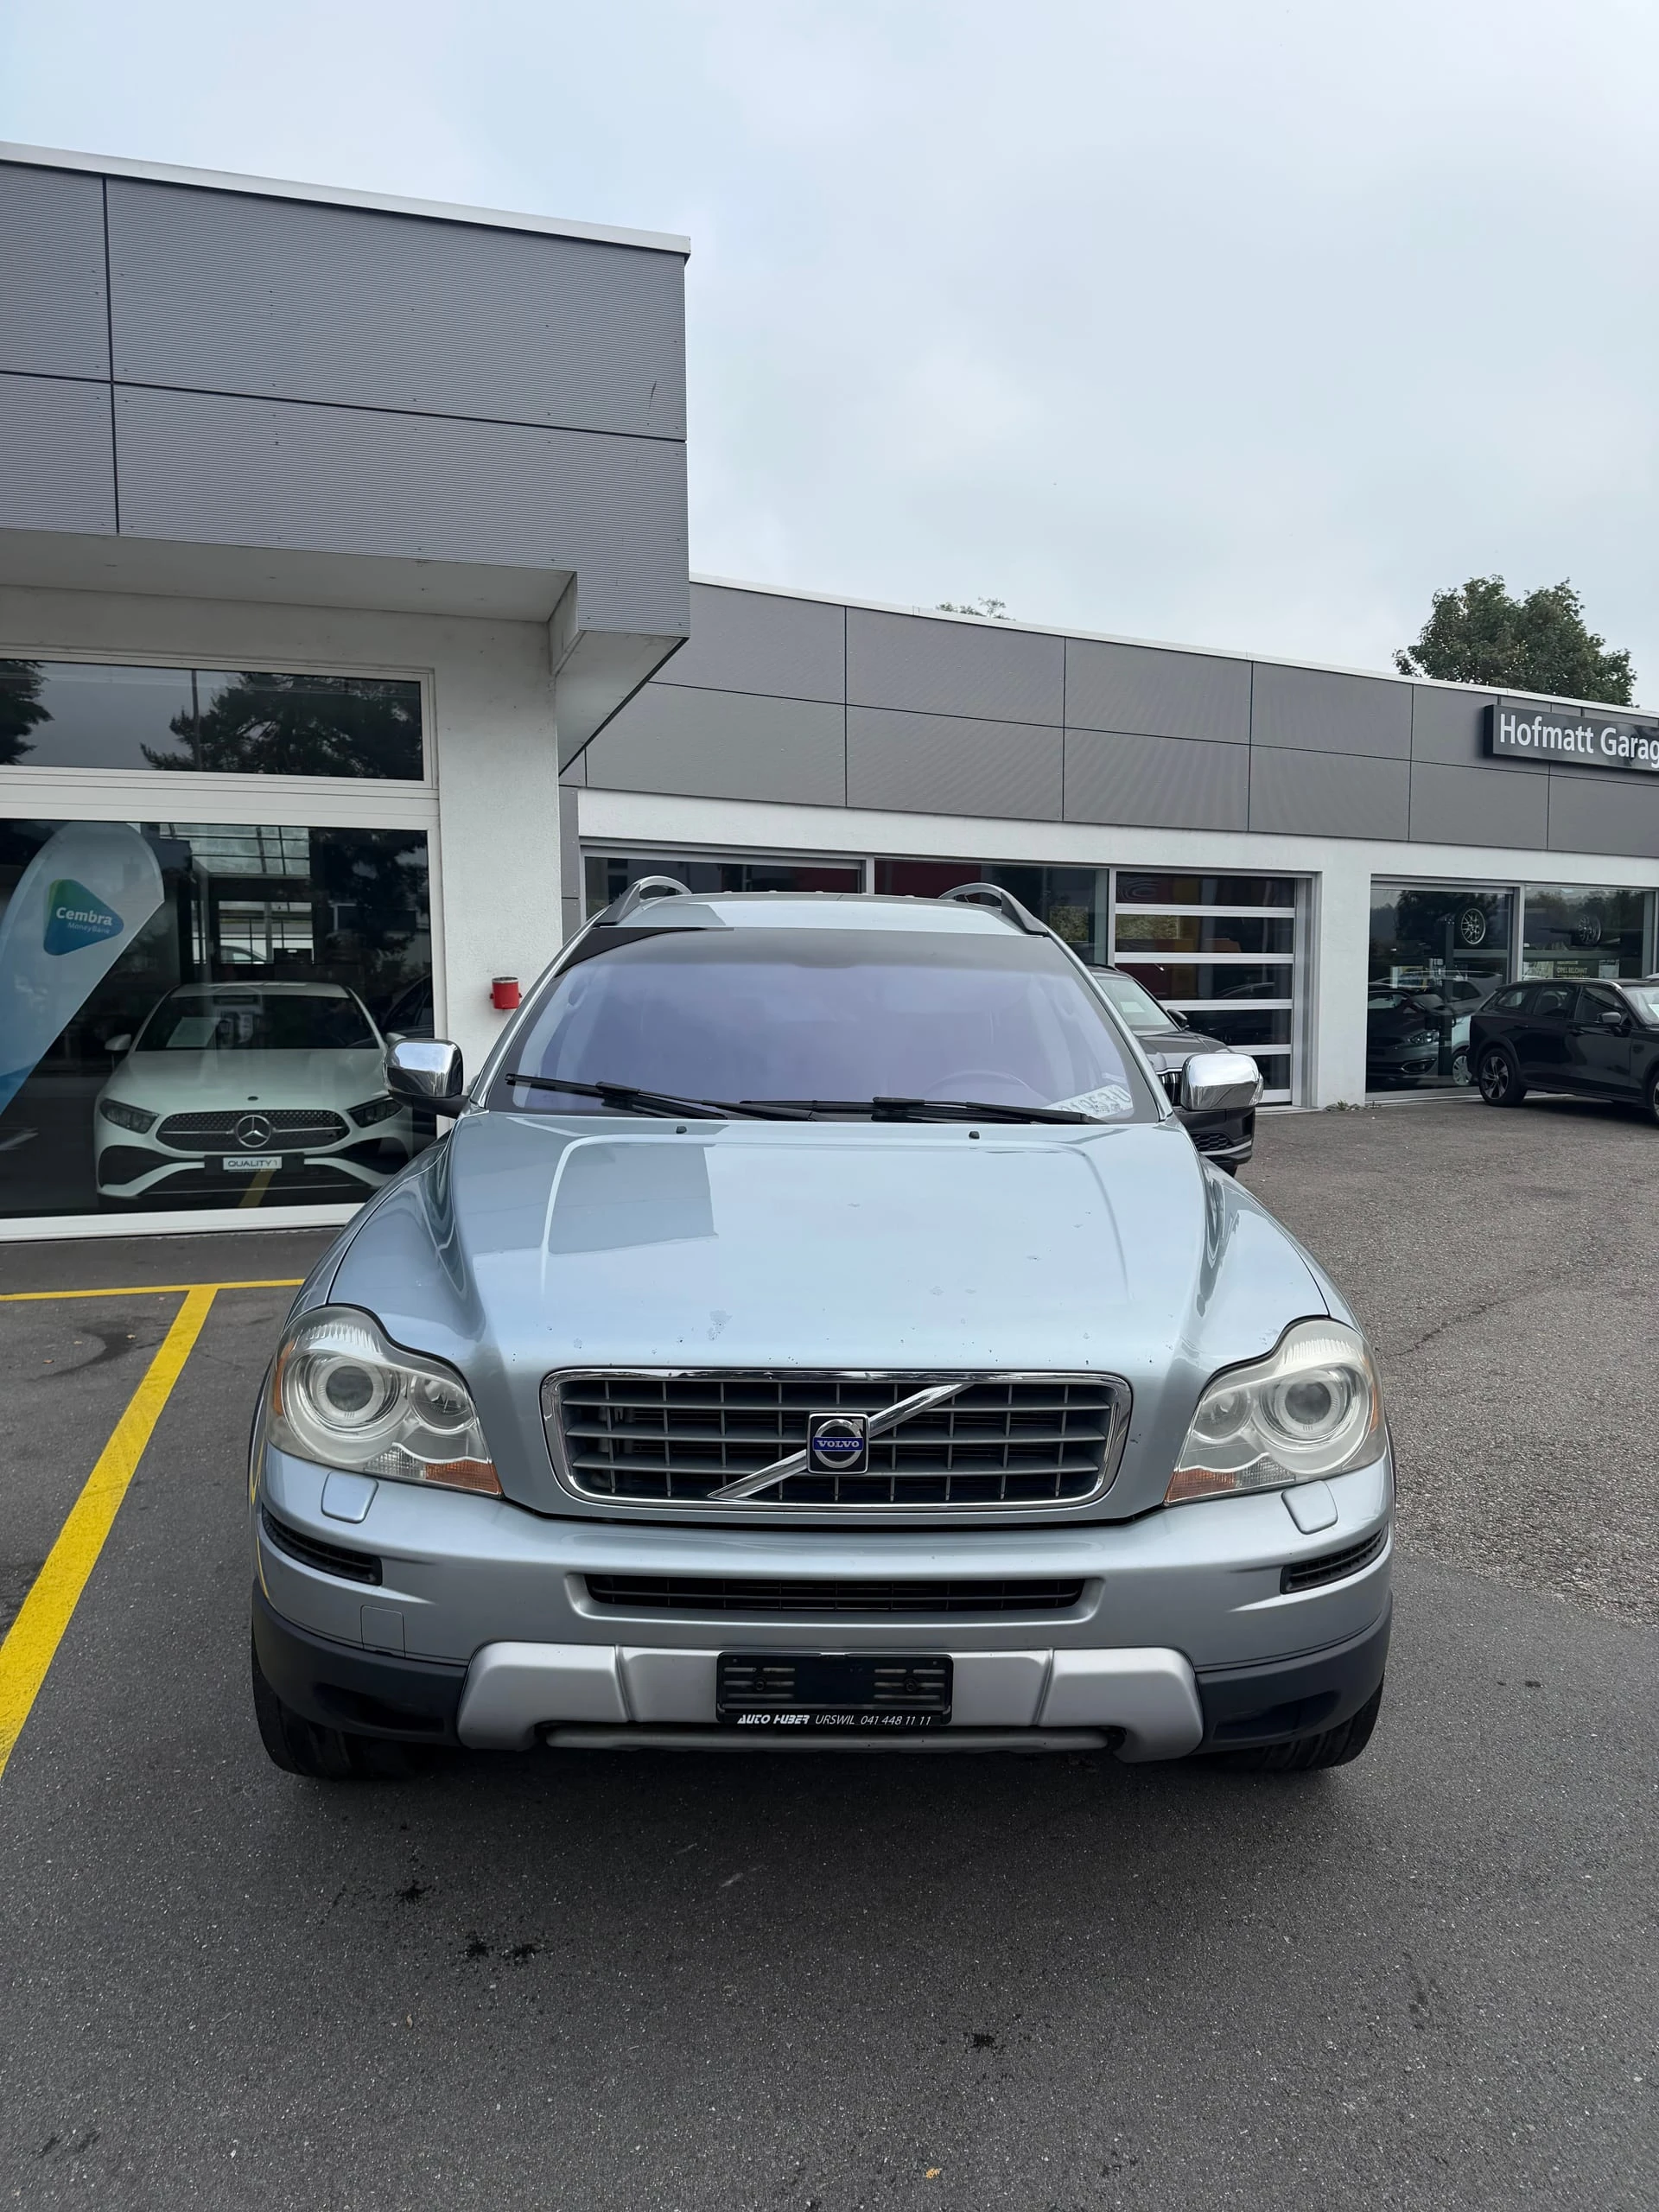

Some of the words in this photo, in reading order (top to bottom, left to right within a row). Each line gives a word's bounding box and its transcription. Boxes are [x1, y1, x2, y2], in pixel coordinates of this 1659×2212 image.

[1500, 714, 1593, 753] Hofmatt
[56, 906, 112, 925] Cembra
[817, 1440, 860, 1448] VOLVO
[737, 1714, 771, 1724] AUTO
[773, 1714, 810, 1725] HUBER
[815, 1714, 855, 1725] URSWIL
[860, 1715, 880, 1725] 041
[881, 1715, 903, 1726] 448
[906, 1715, 916, 1726] 11
[919, 1715, 931, 1726] 11
